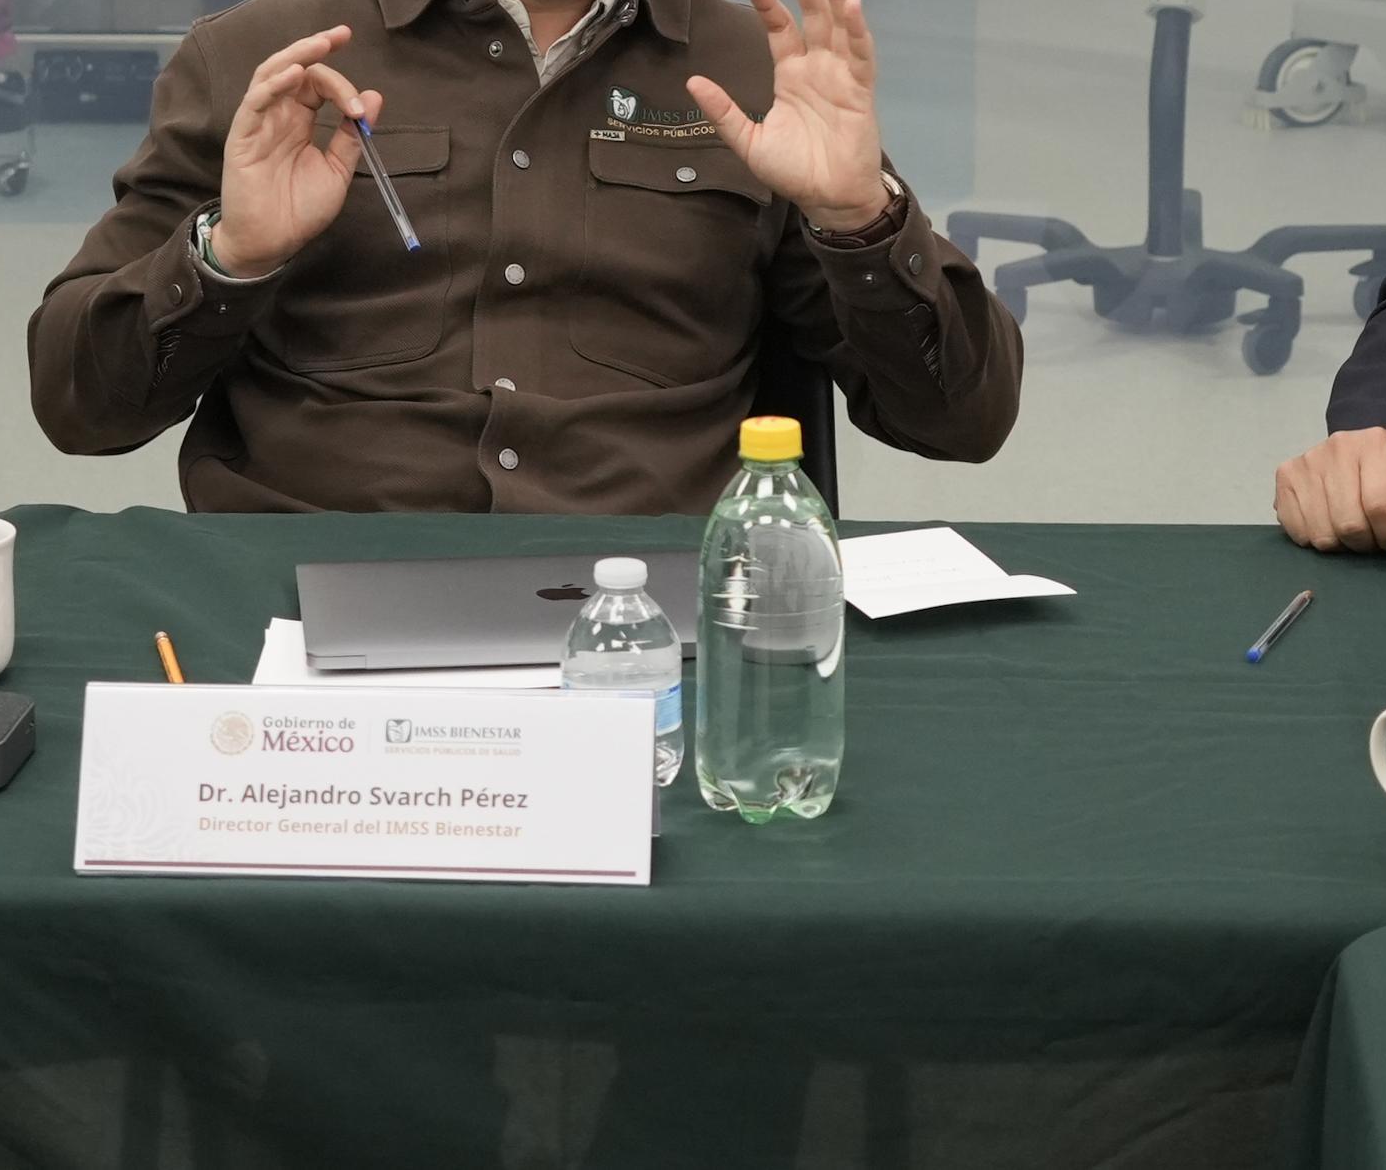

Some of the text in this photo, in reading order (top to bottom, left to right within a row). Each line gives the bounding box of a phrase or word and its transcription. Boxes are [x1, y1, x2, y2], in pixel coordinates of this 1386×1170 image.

[607, 117, 660, 136] SERVICIOS
[263, 717, 356, 730] Gobierno de
[415, 726, 522, 740] IMSS BIENESTAR
[261, 729, 354, 753] México
[199, 783, 528, 809] Dr. Alejandro Svarch Pérez
[199, 817, 522, 837] Director General del IMSS Bienestar
